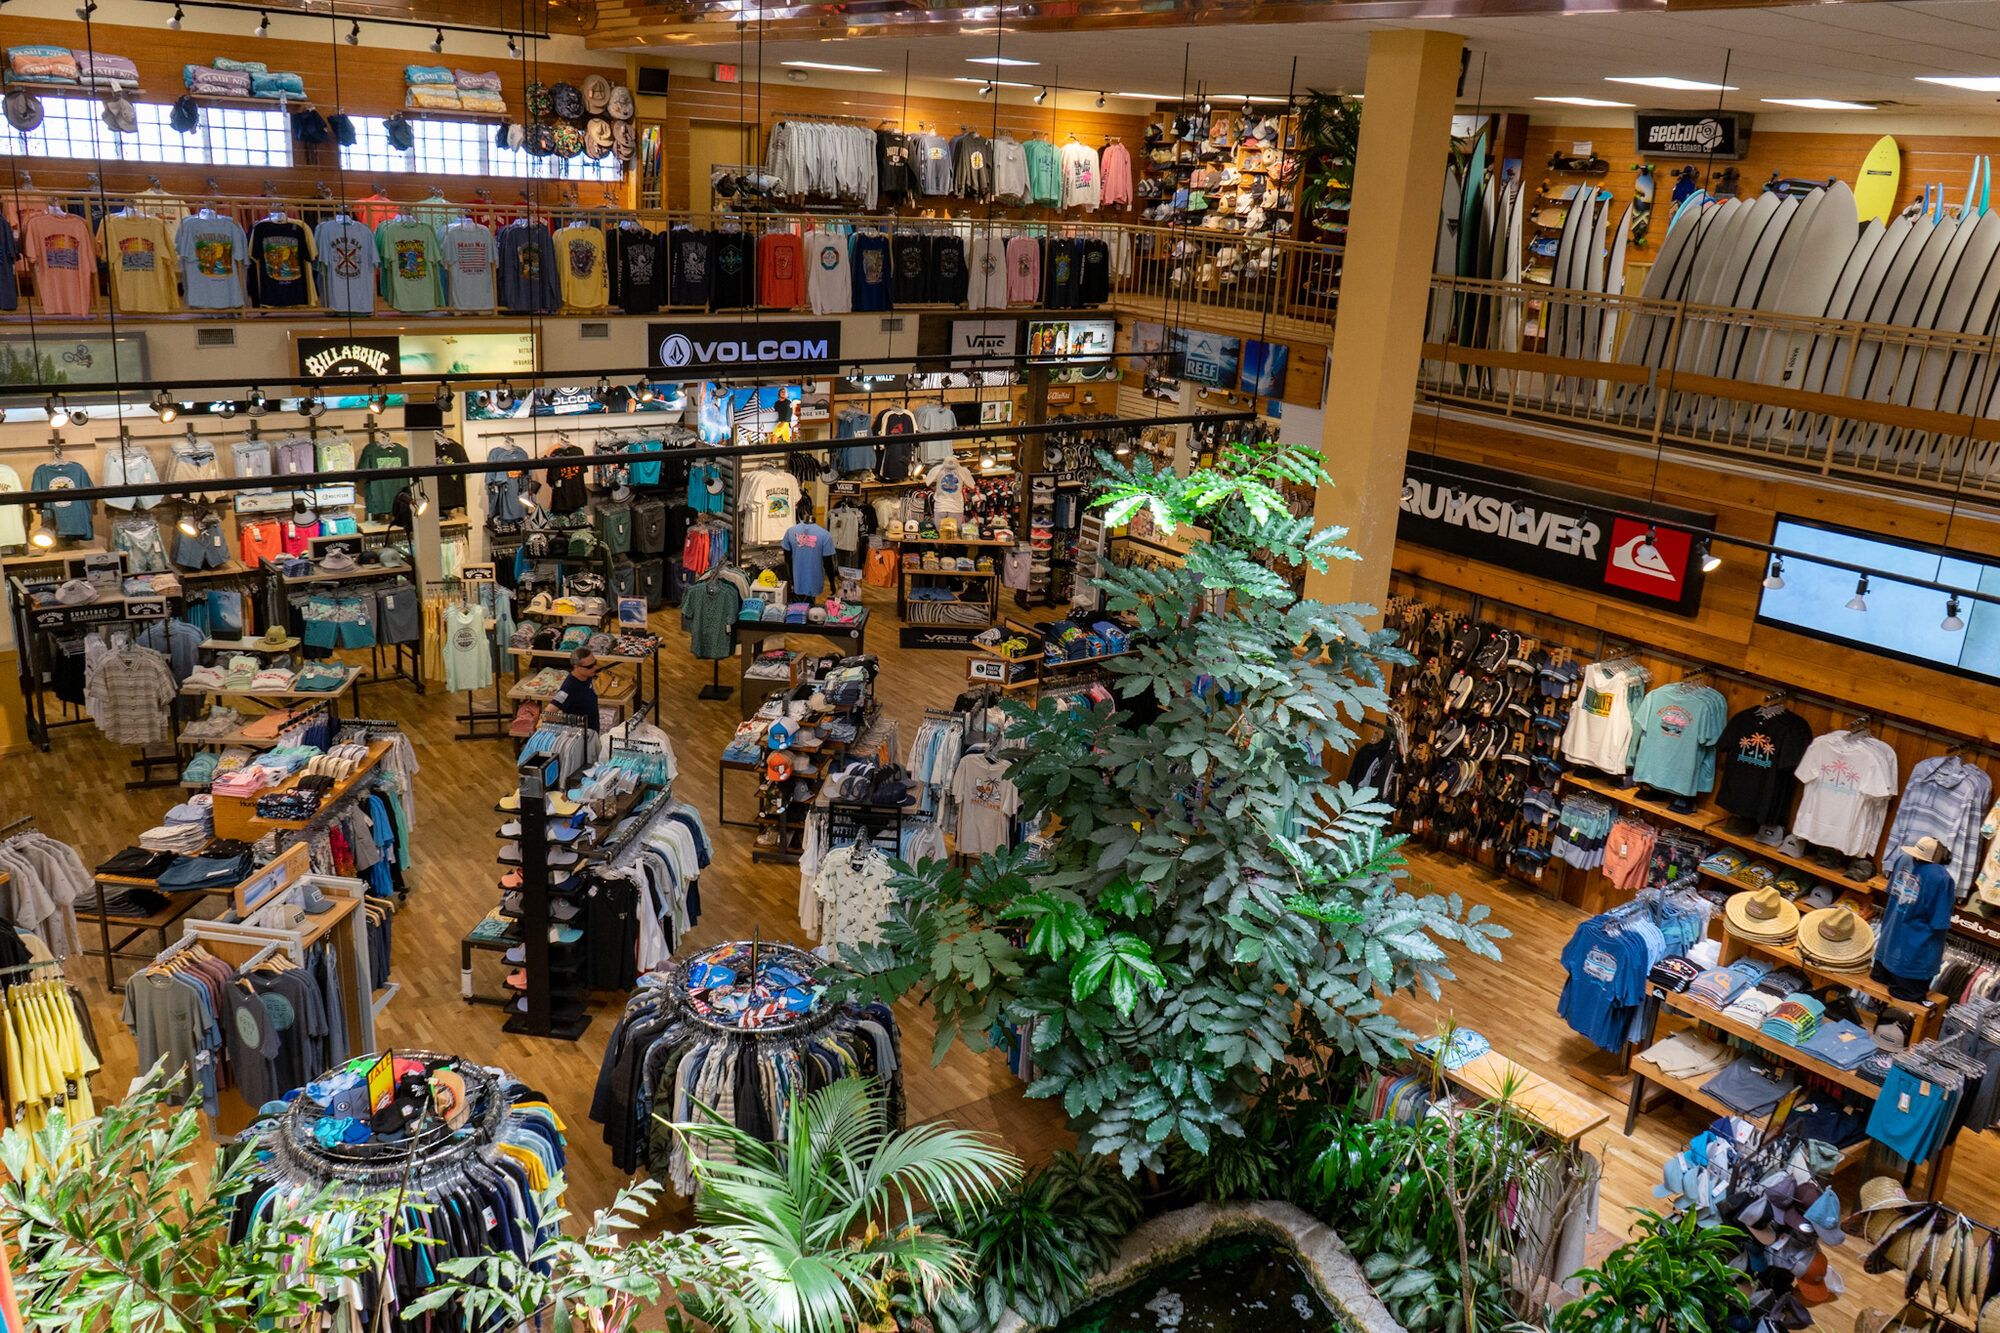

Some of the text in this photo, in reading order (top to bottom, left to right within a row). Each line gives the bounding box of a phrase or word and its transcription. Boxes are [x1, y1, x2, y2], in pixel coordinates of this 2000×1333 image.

[719, 65, 736, 80] EXIT
[1664, 143, 1702, 153] SKATEBOARD
[965, 335, 1007, 349] VANS
[693, 339, 829, 363] VOLCOM
[305, 345, 391, 376] BILLABONG
[1187, 360, 1218, 379] REEF
[836, 483, 854, 491] VANS
[1400, 477, 1601, 561] QUIKSILVER
[924, 633, 968, 641] VANS
[369, 1055, 392, 1085] SALE
